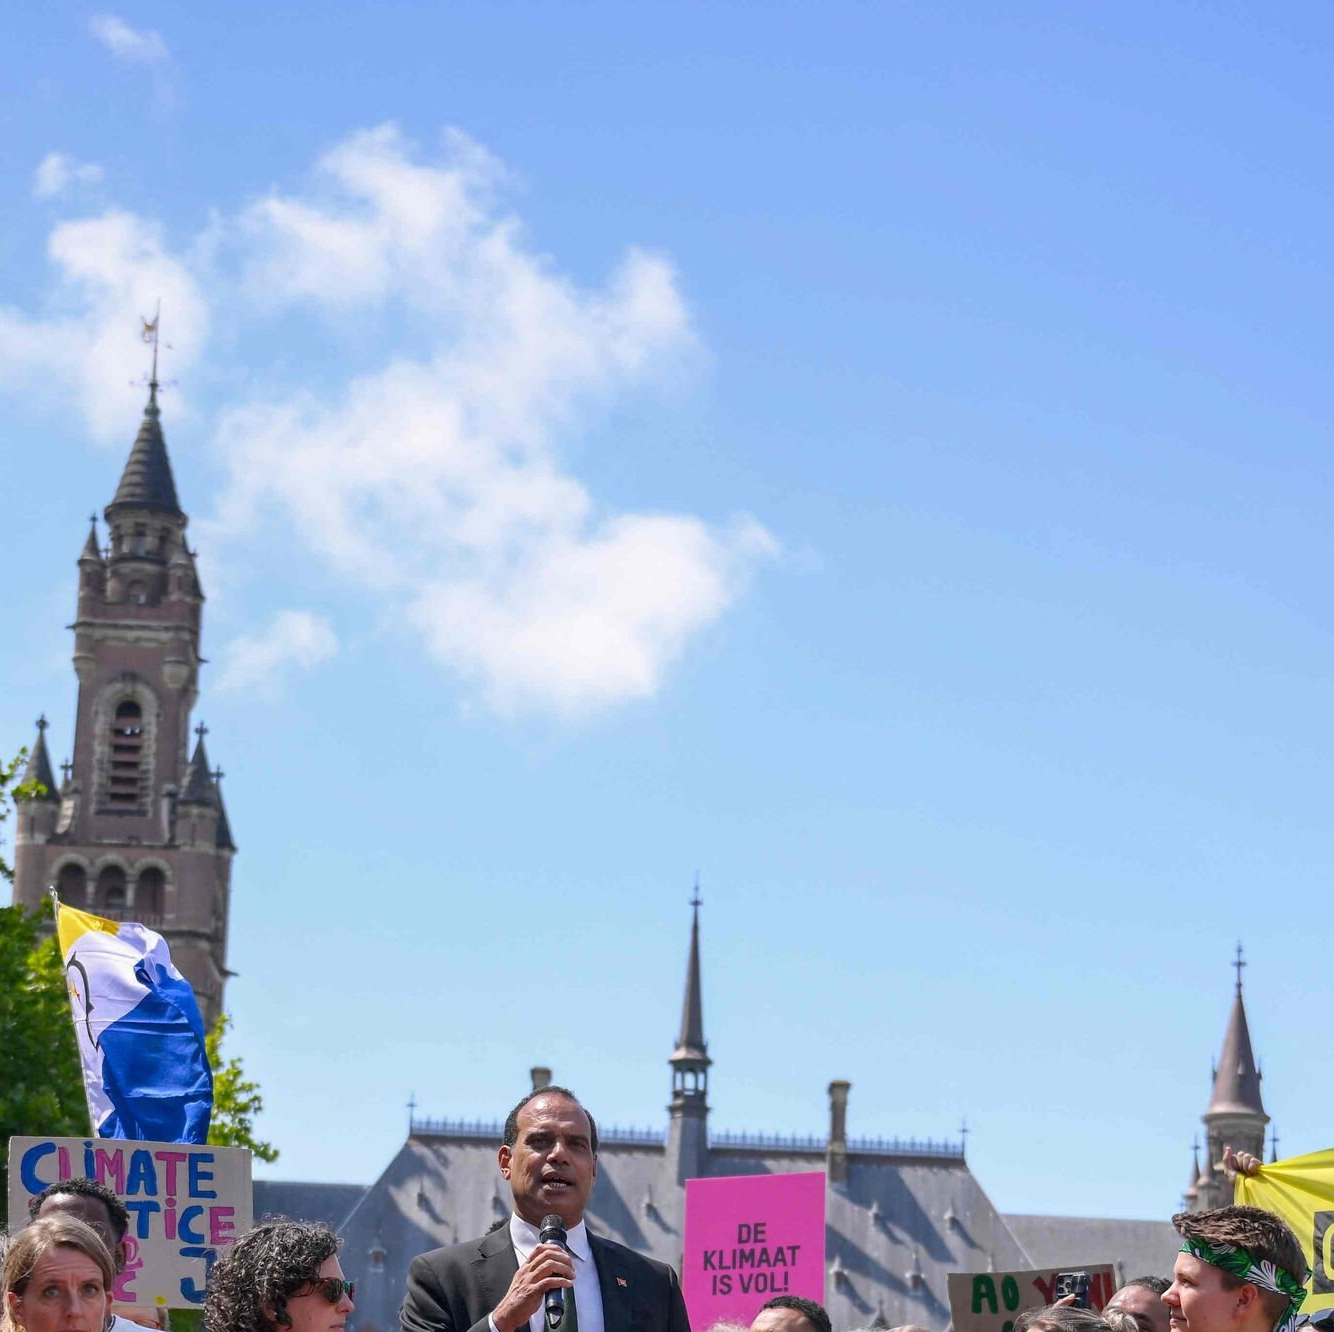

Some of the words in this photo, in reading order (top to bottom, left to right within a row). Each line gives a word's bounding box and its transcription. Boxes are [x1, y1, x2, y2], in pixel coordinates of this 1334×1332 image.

[738, 1223, 766, 1244] DE
[703, 1245, 801, 1271] KLIMAAT
[712, 1274, 732, 1296] IS
[739, 1272, 789, 1294] VOL!
[971, 1274, 1020, 1314] AO
